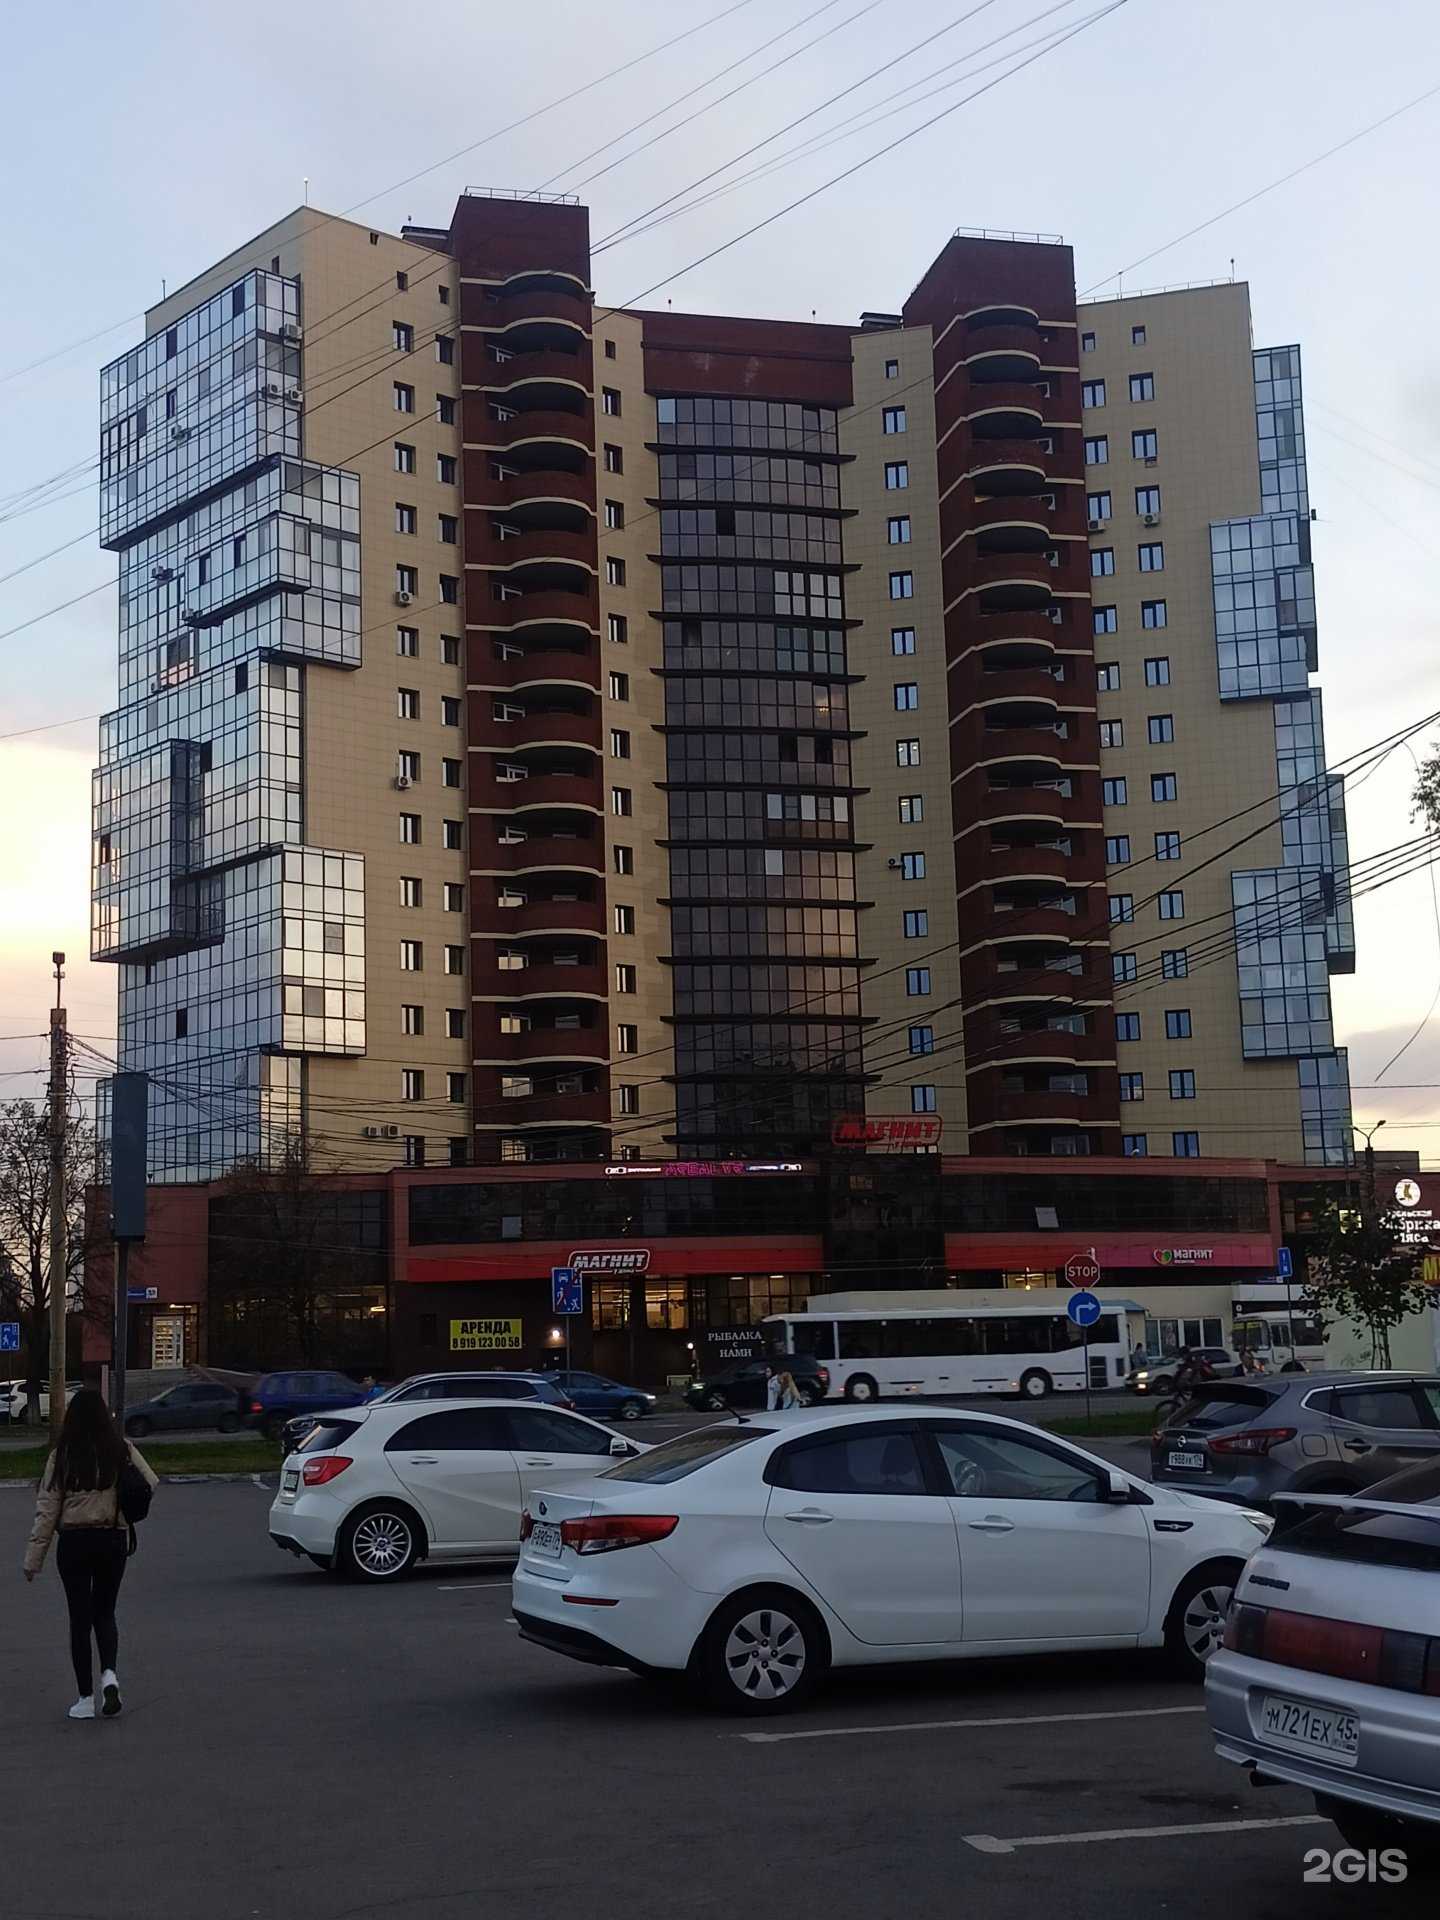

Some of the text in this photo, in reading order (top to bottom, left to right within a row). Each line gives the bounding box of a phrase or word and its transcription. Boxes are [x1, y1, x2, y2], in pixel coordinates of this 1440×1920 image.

[573, 1254, 646, 1268] МАГНИТ
[1068, 1265, 1098, 1277] STOP
[461, 1321, 512, 1335] АРЕНДА
[452, 1336, 521, 1349] 8 919 123 00 58
